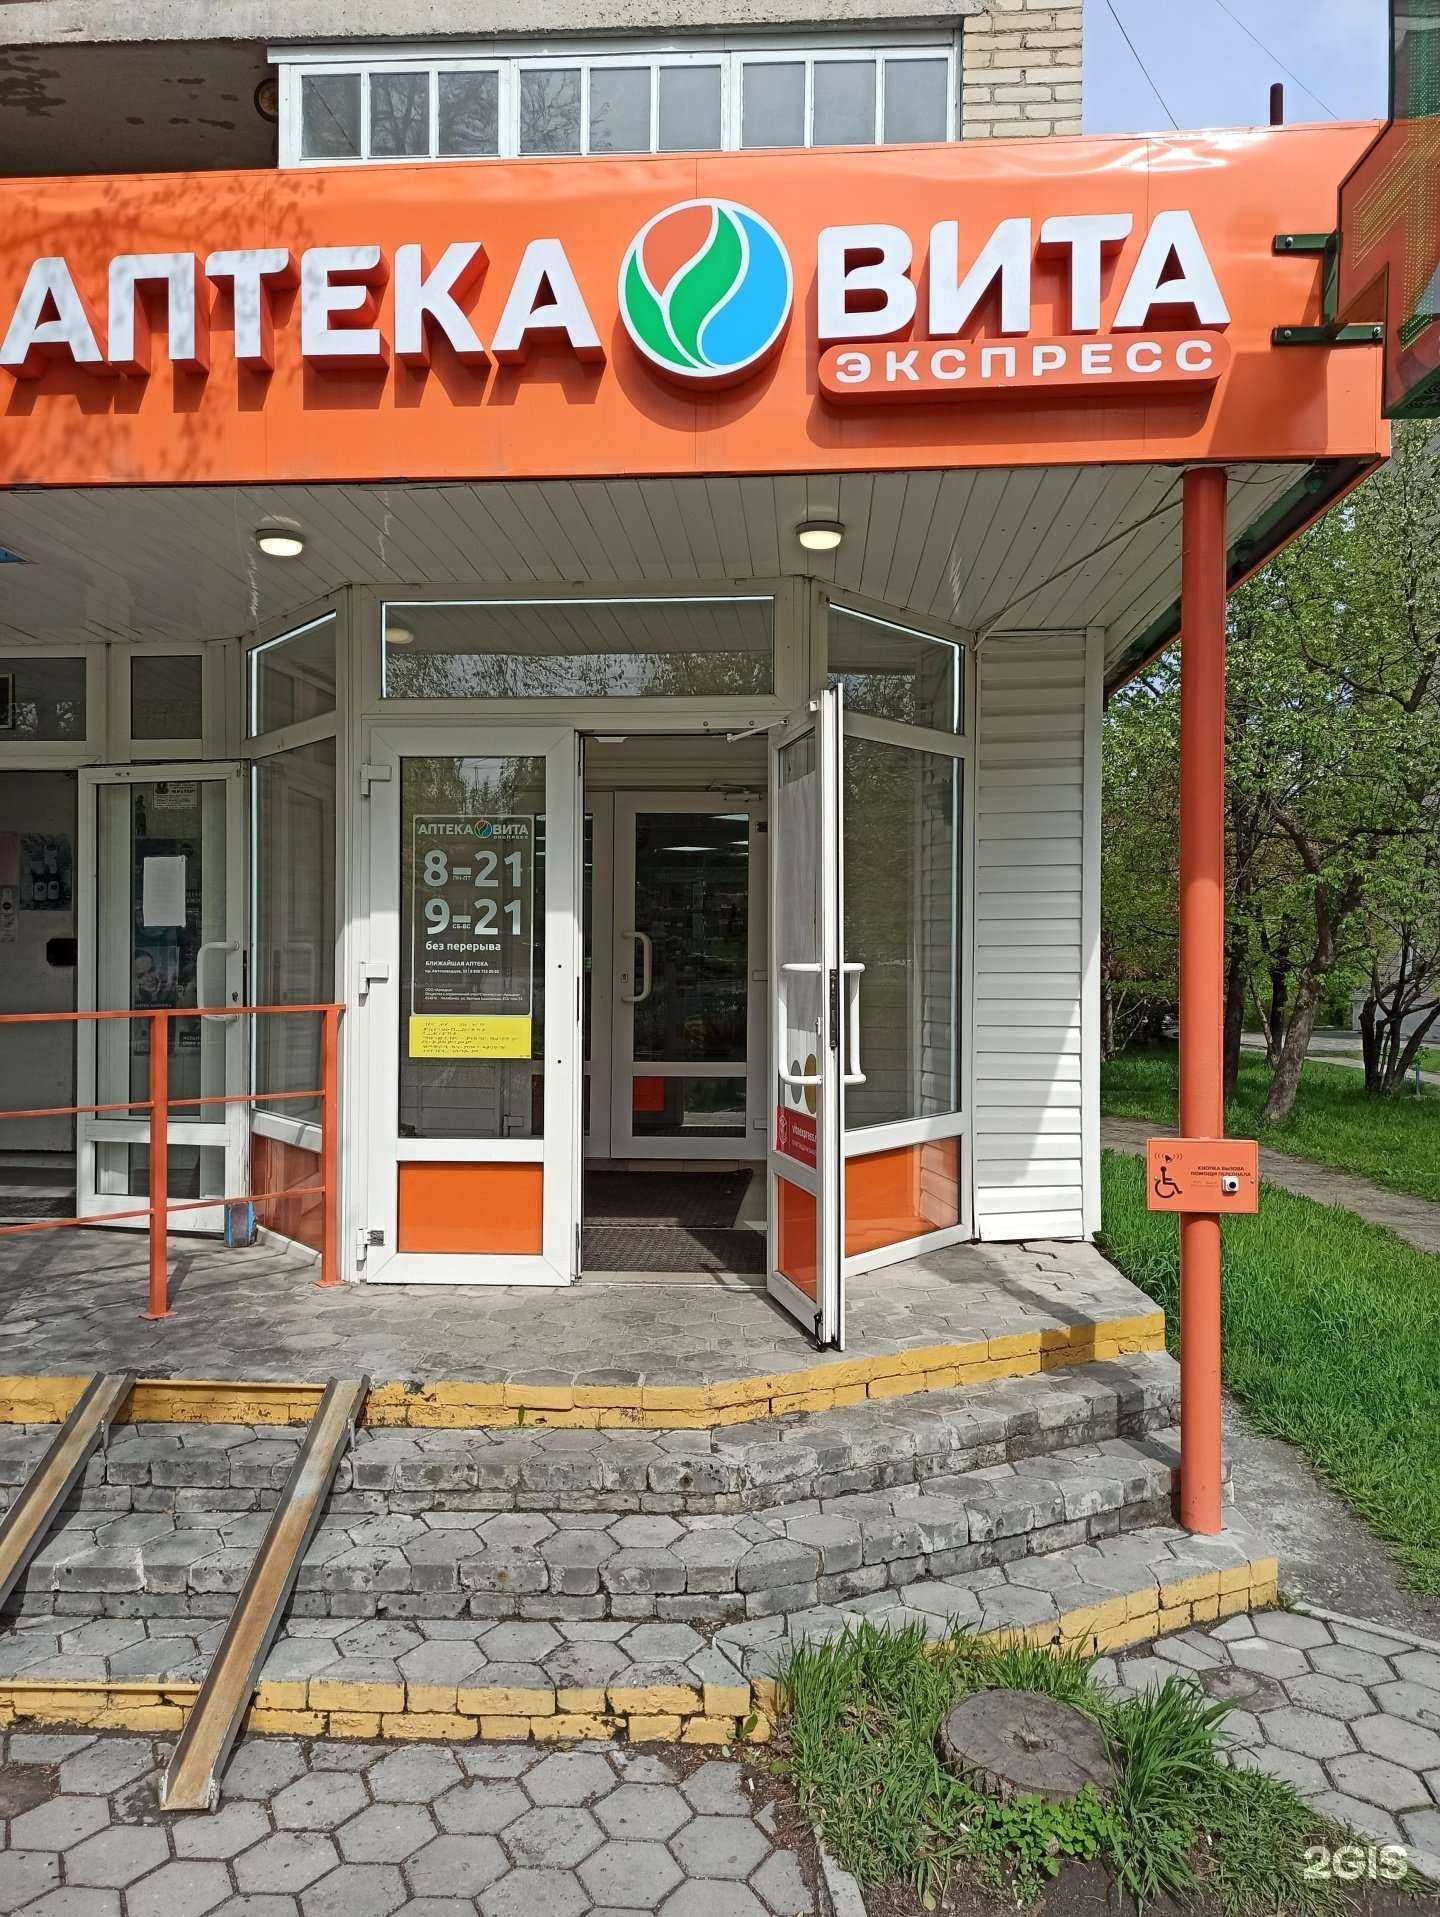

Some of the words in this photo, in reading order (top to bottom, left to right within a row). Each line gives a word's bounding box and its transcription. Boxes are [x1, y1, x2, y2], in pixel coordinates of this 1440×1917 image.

[0, 238, 603, 366] АПТЕКА
[817, 209, 1231, 339] ВИТА
[834, 339, 1213, 384] ЭКСПРЕСС
[417, 823, 474, 835] АПТЕКА
[492, 824, 529, 835] ВИТА
[425, 940, 445, 951] без
[446, 942, 502, 953] перерыва
